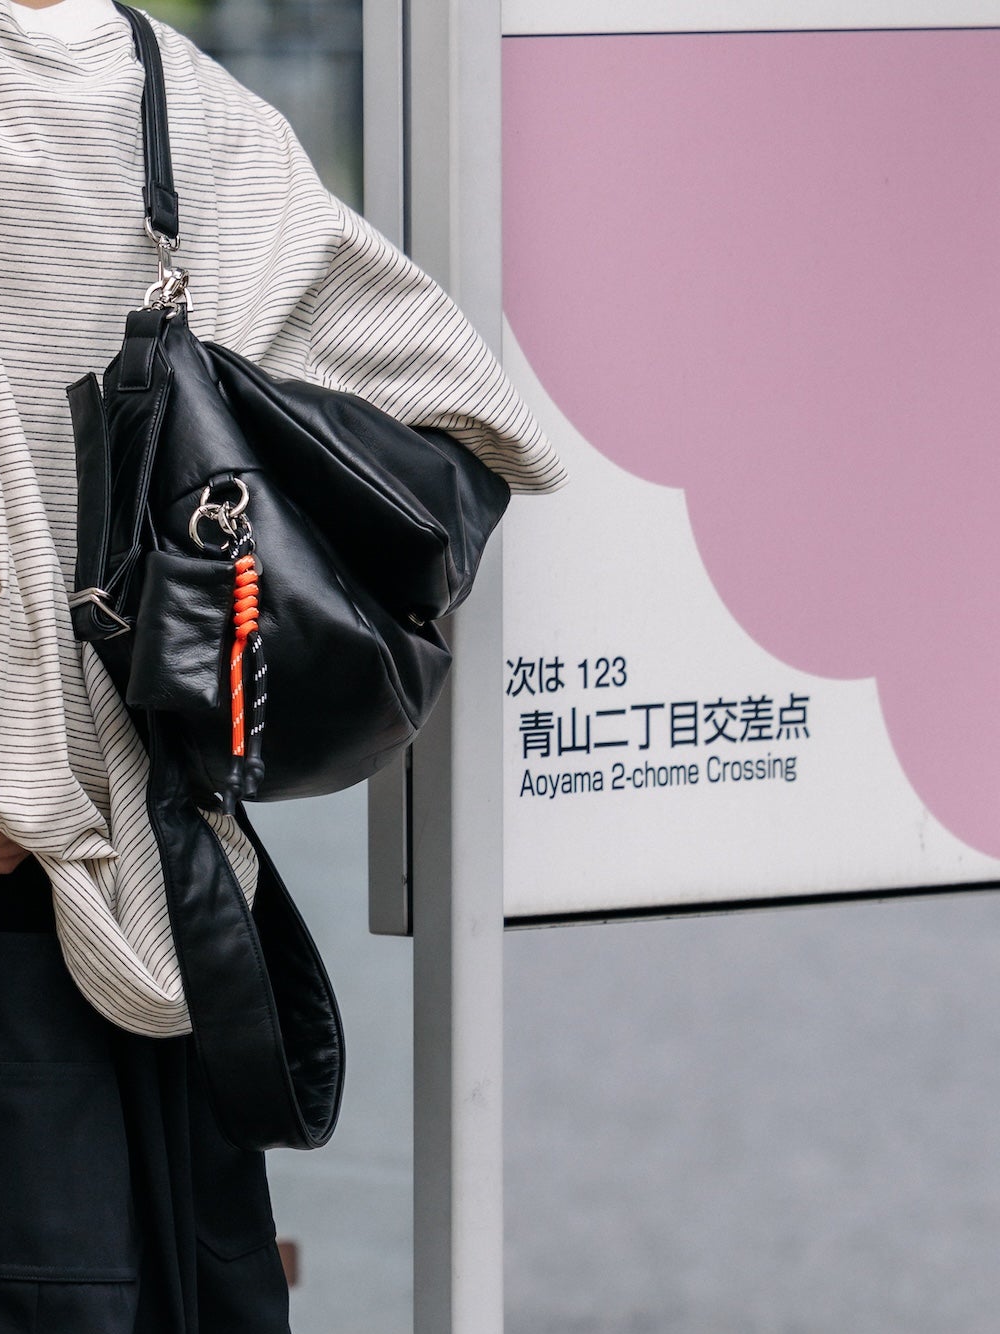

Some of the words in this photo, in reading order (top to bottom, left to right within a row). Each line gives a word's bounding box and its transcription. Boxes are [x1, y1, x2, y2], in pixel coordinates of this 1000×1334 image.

[505, 655, 566, 697] 次は
[577, 655, 628, 690] 123
[518, 692, 811, 760] 青山二丁目交差点
[519, 768, 604, 800] Aoyama
[611, 760, 700, 790] 2-chome
[706, 752, 798, 783] Crossing
